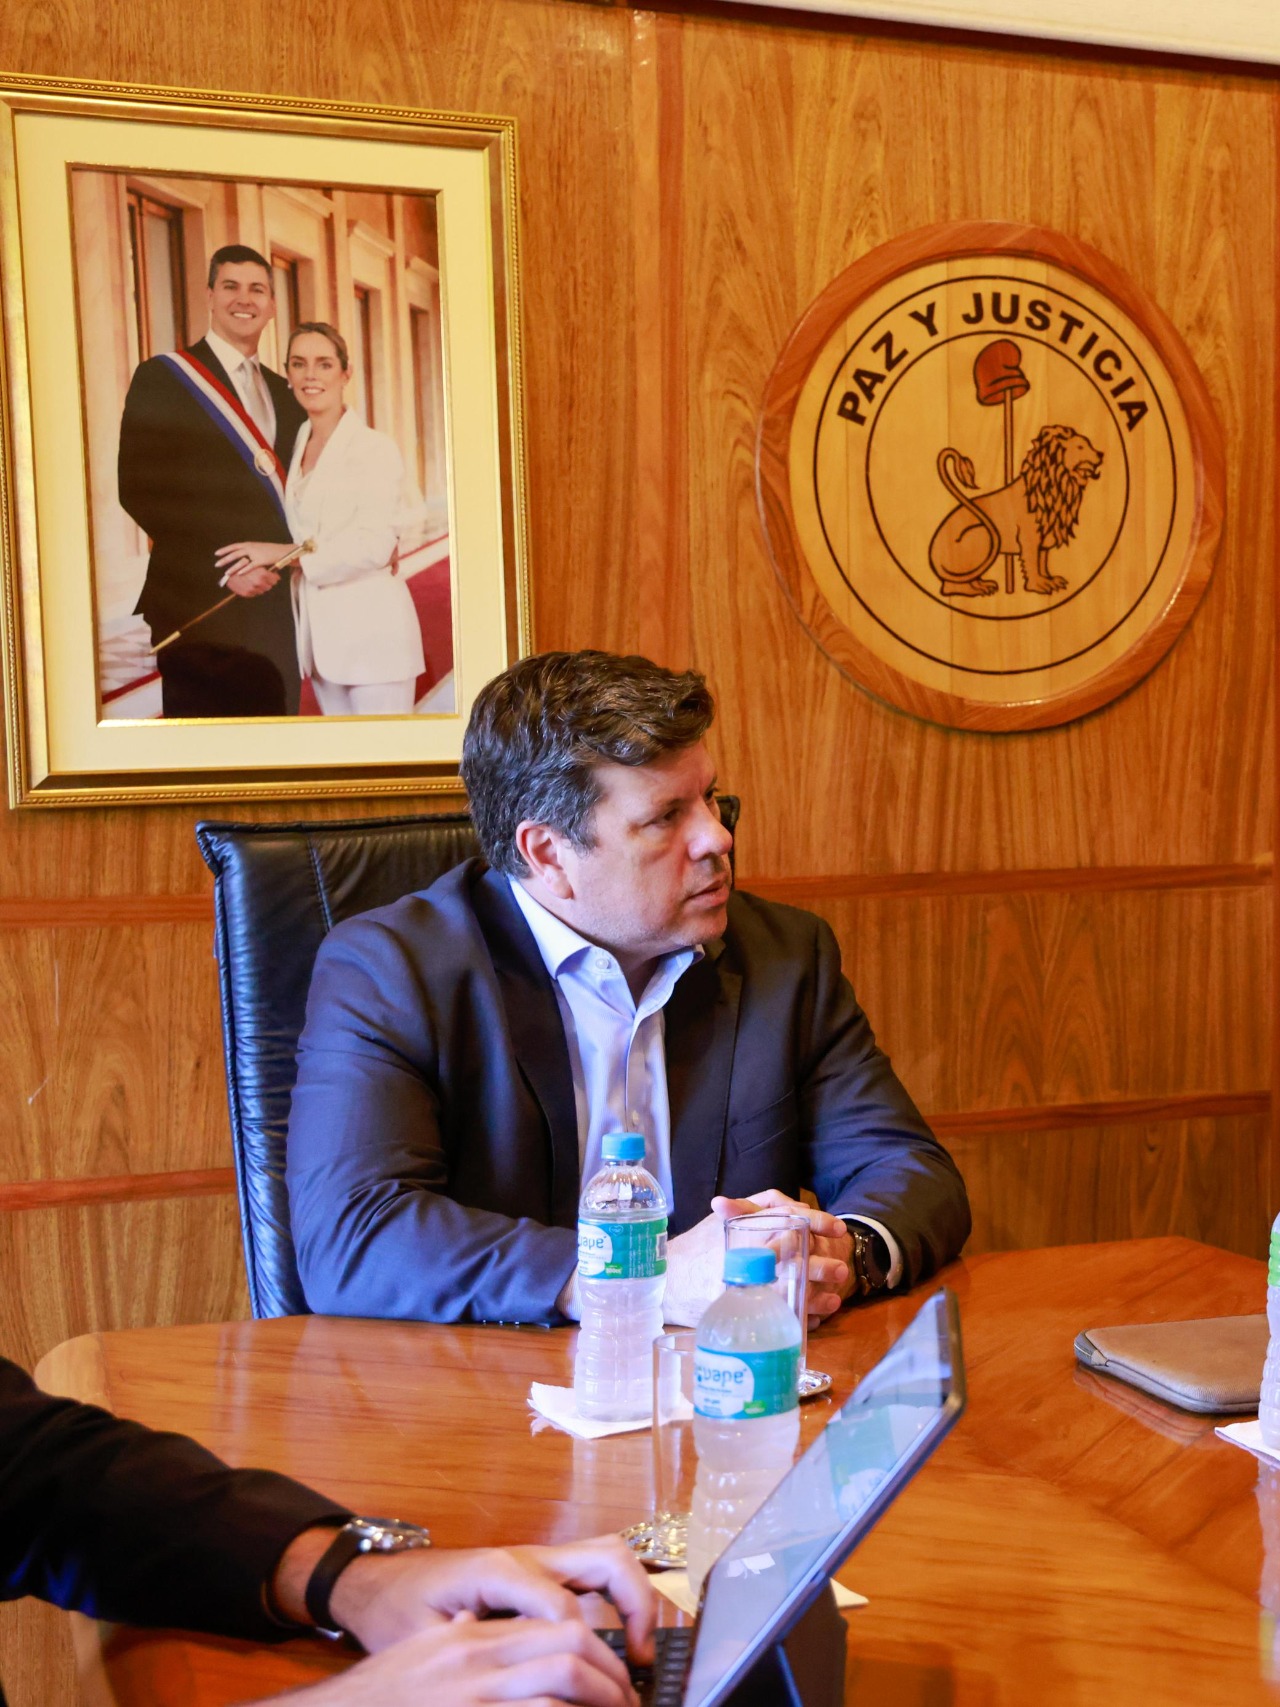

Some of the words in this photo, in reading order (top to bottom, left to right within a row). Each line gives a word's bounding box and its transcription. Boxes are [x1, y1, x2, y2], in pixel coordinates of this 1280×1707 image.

[836, 331, 908, 426] PAZ
[908, 302, 938, 337] Y
[961, 292, 1149, 432] JUSTICIA
